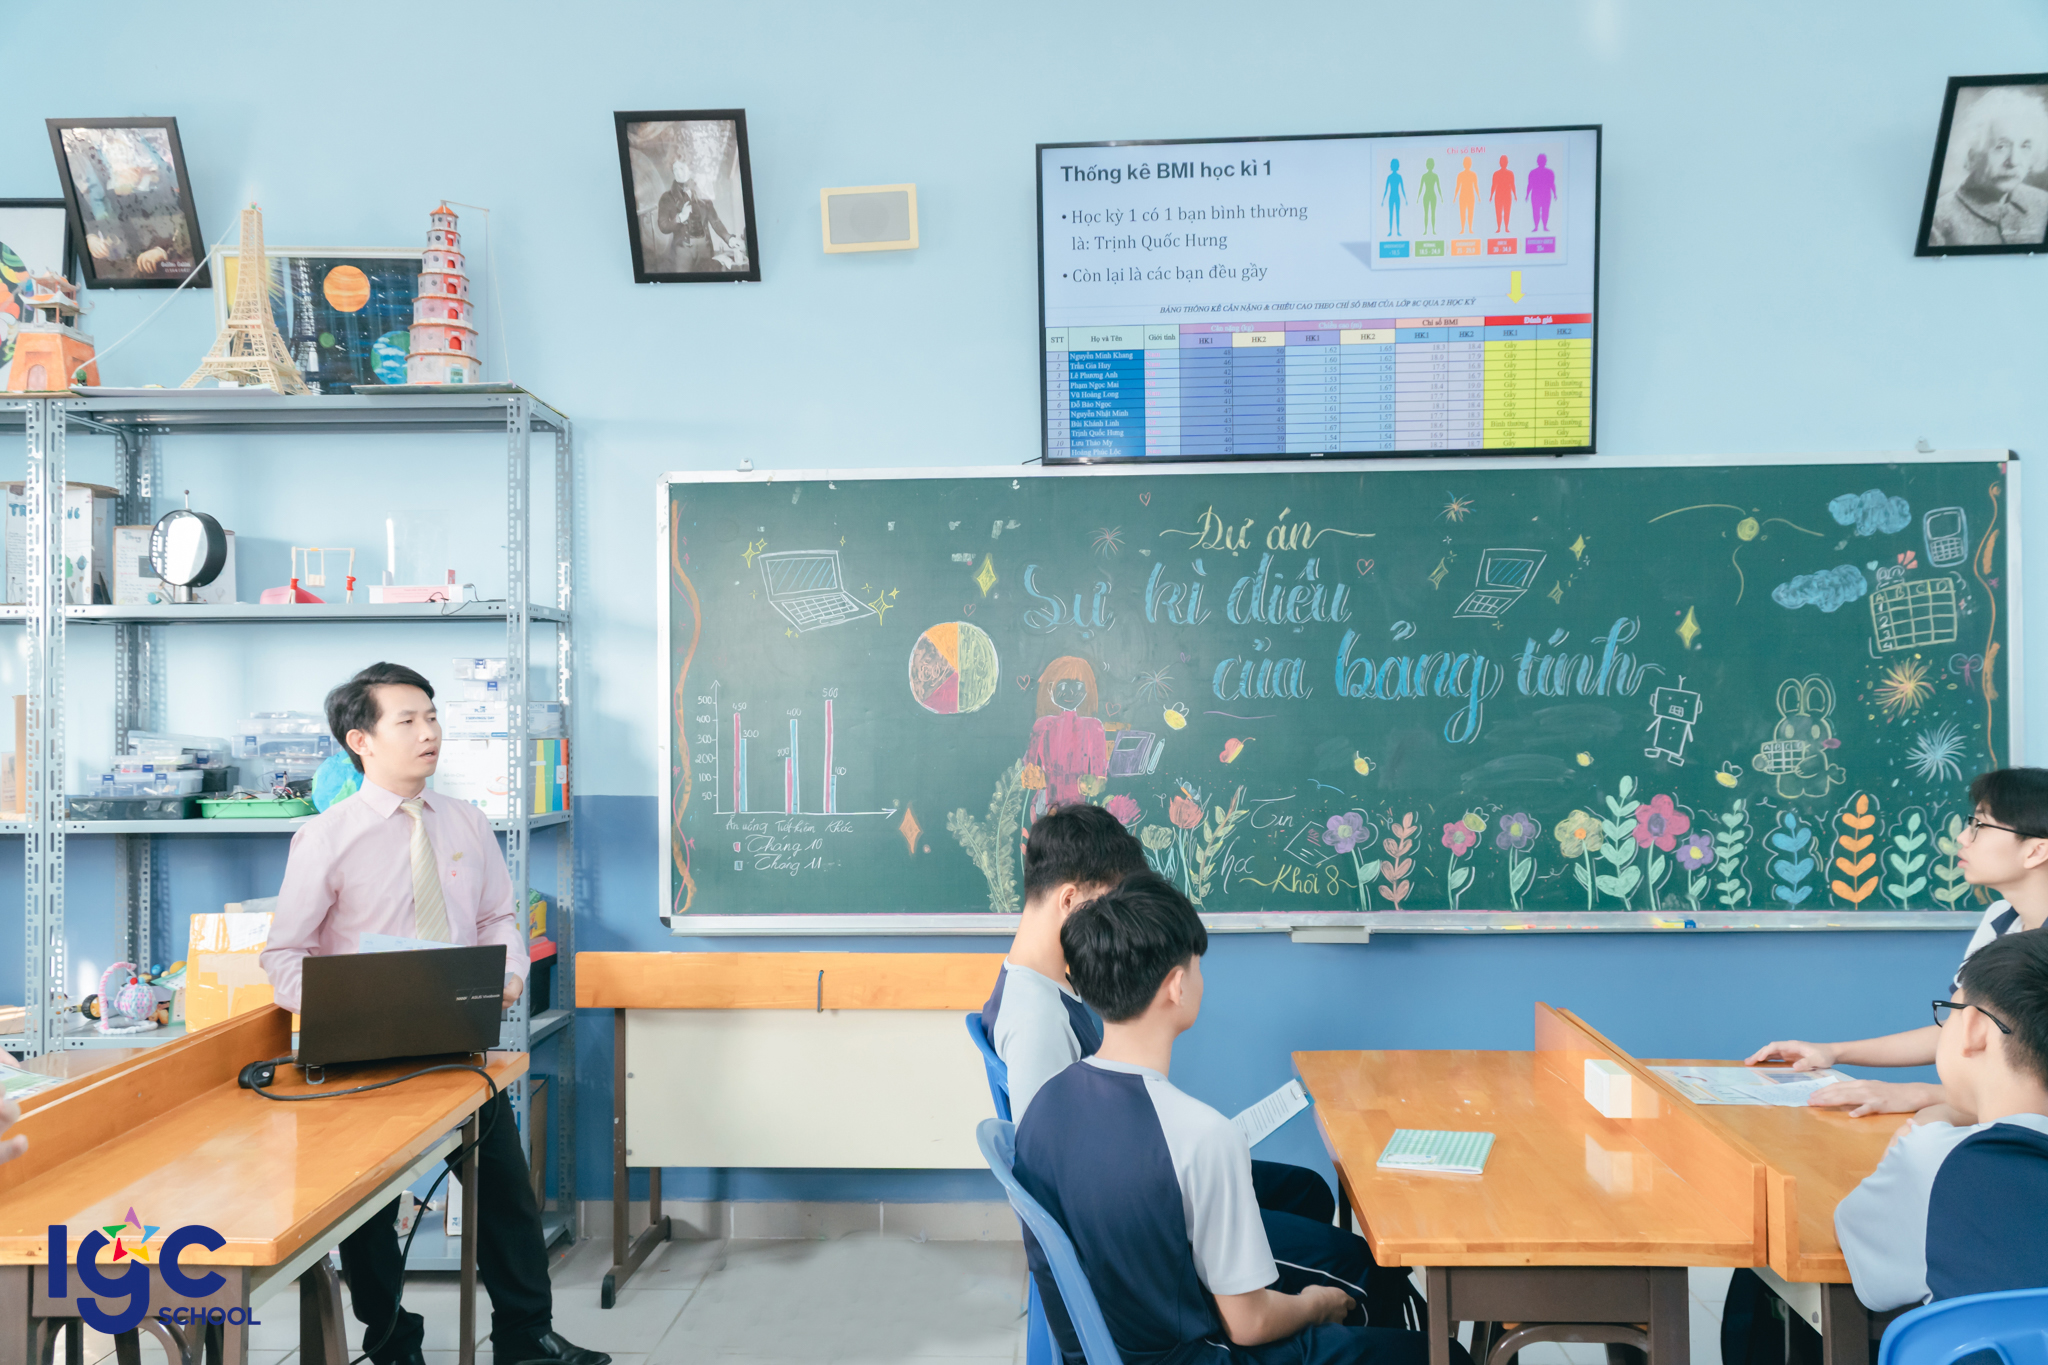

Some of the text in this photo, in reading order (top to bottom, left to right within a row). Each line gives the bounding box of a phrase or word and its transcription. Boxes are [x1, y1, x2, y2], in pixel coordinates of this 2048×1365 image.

[1470, 146, 1486, 154] BMI
[1061, 159, 1271, 184] Thống kê BMI học kì 1
[1072, 204, 1308, 227] Học kỳ 1 có 1 bạn bình thường
[1072, 232, 1228, 253] là: Trịnh Quốc Hưng
[1072, 263, 1268, 284] Còn lại là các bạn đều gầy
[1314, 302, 1335, 310] THEO
[1422, 299, 1439, 307] QUA
[1435, 318, 1443, 326] số
[1241, 324, 1254, 333] (kg)
[1090, 336, 1101, 344] Họ
[1163, 333, 1176, 341] tính
[1199, 337, 1213, 345] HK1
[1113, 352, 1133, 360] Khang
[1098, 362, 1111, 370] Huy
[1070, 382, 1088, 390] Phạm
[1088, 381, 1106, 390] Ngọc
[1103, 391, 1119, 399] Long
[1095, 401, 1112, 409] Ngọc
[1180, 505, 1334, 556] Dự án
[1916, 584, 1925, 594] C
[1936, 580, 1947, 592] D
[1023, 564, 1115, 638] Sự
[1145, 558, 1211, 625] kì
[1879, 616, 1889, 628] 2
[1883, 630, 1891, 640] 3
[1213, 616, 1652, 744] của bảng tính
[822, 687, 839, 698] 500
[697, 696, 713, 705] 500
[732, 702, 747, 711] 450
[786, 708, 802, 717] 400
[696, 715, 711, 723] 400
[743, 729, 759, 738] 300
[696, 735, 712, 744] 300
[695, 753, 713, 763] 200
[835, 767, 847, 776] 100
[699, 773, 712, 782] 100
[702, 791, 712, 801] 50
[1250, 794, 1296, 829] Tin
[825, 819, 854, 833] Khác
[745, 833, 823, 857] Tháng 10
[754, 853, 822, 877] Tháng 11
[1266, 864, 1339, 896] Khối 8
